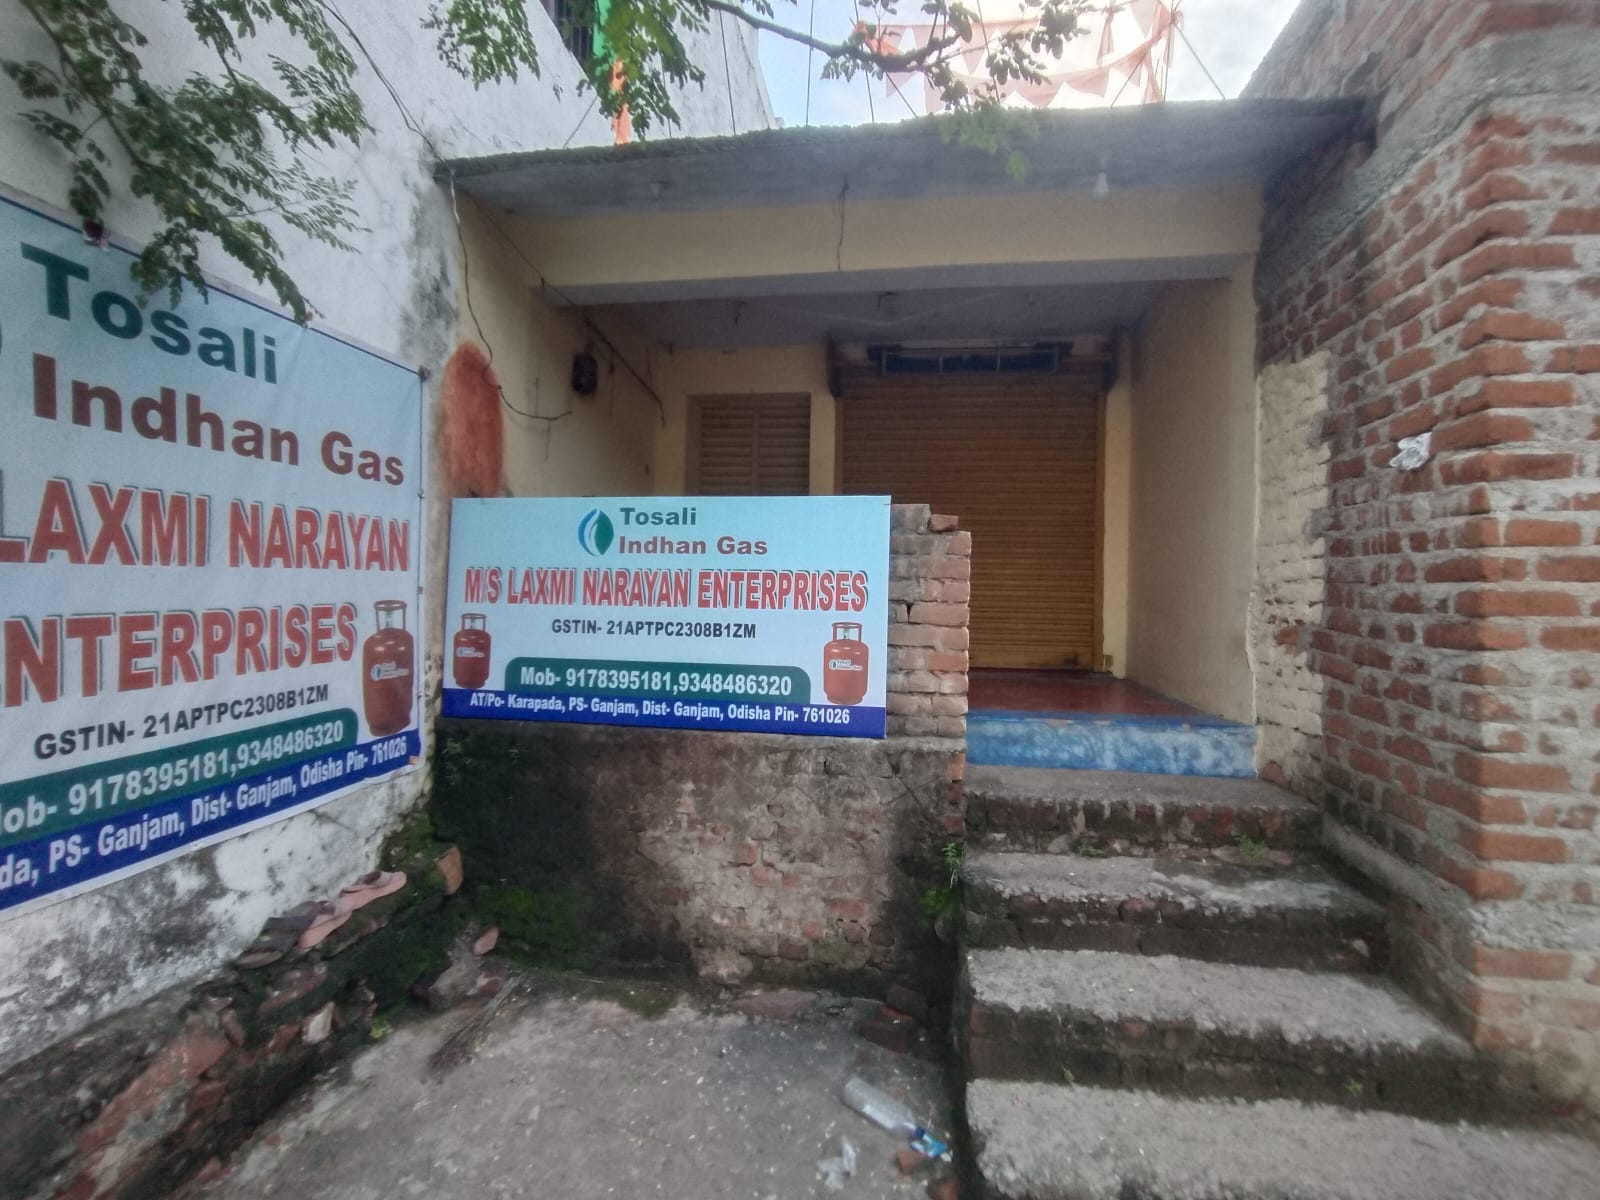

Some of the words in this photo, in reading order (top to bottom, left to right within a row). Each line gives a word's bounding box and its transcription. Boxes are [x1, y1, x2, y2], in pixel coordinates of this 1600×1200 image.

[21, 242, 277, 384] Tosali
[33, 353, 298, 466] Indhan
[321, 431, 404, 486] Gas
[229, 499, 410, 572] NARAYAN
[619, 536, 706, 554] Indhan
[717, 536, 768, 555] Gas
[620, 507, 697, 526] Tosali
[507, 567, 576, 606] LAXMI
[582, 568, 691, 609] NARAYAN
[698, 568, 868, 612] ENTERPRISES
[0, 602, 358, 708] NTERPRISES
[552, 619, 602, 634] GSTIN-
[606, 620, 756, 638] 21APTPC2308B1ZM
[508, 694, 565, 713] Karapada,
[568, 697, 587, 712] PS-
[591, 697, 639, 717] Ganjam,
[642, 701, 670, 717] Dist-
[674, 702, 724, 720] Ganjam,
[728, 705, 770, 720] Odisha
[775, 706, 799, 721] Pin-
[803, 707, 850, 724] 761026
[521, 667, 560, 685] Mob-
[566, 668, 792, 696] 9178395181,9348486320
[34, 719, 134, 760] GSTIN-
[142, 684, 329, 739] 21APTPC2308B1ZM
[0, 794, 58, 834] ob-
[68, 720, 344, 816] 9178395181,9348486320
[49, 834, 91, 873] PS-
[98, 811, 185, 856] Ganjam,
[191, 791, 232, 827] Dist-
[237, 776, 297, 811] Ganjam,
[301, 756, 343, 789] Odisha
[346, 750, 368, 776] Pin-
[372, 736, 407, 766] 761026
